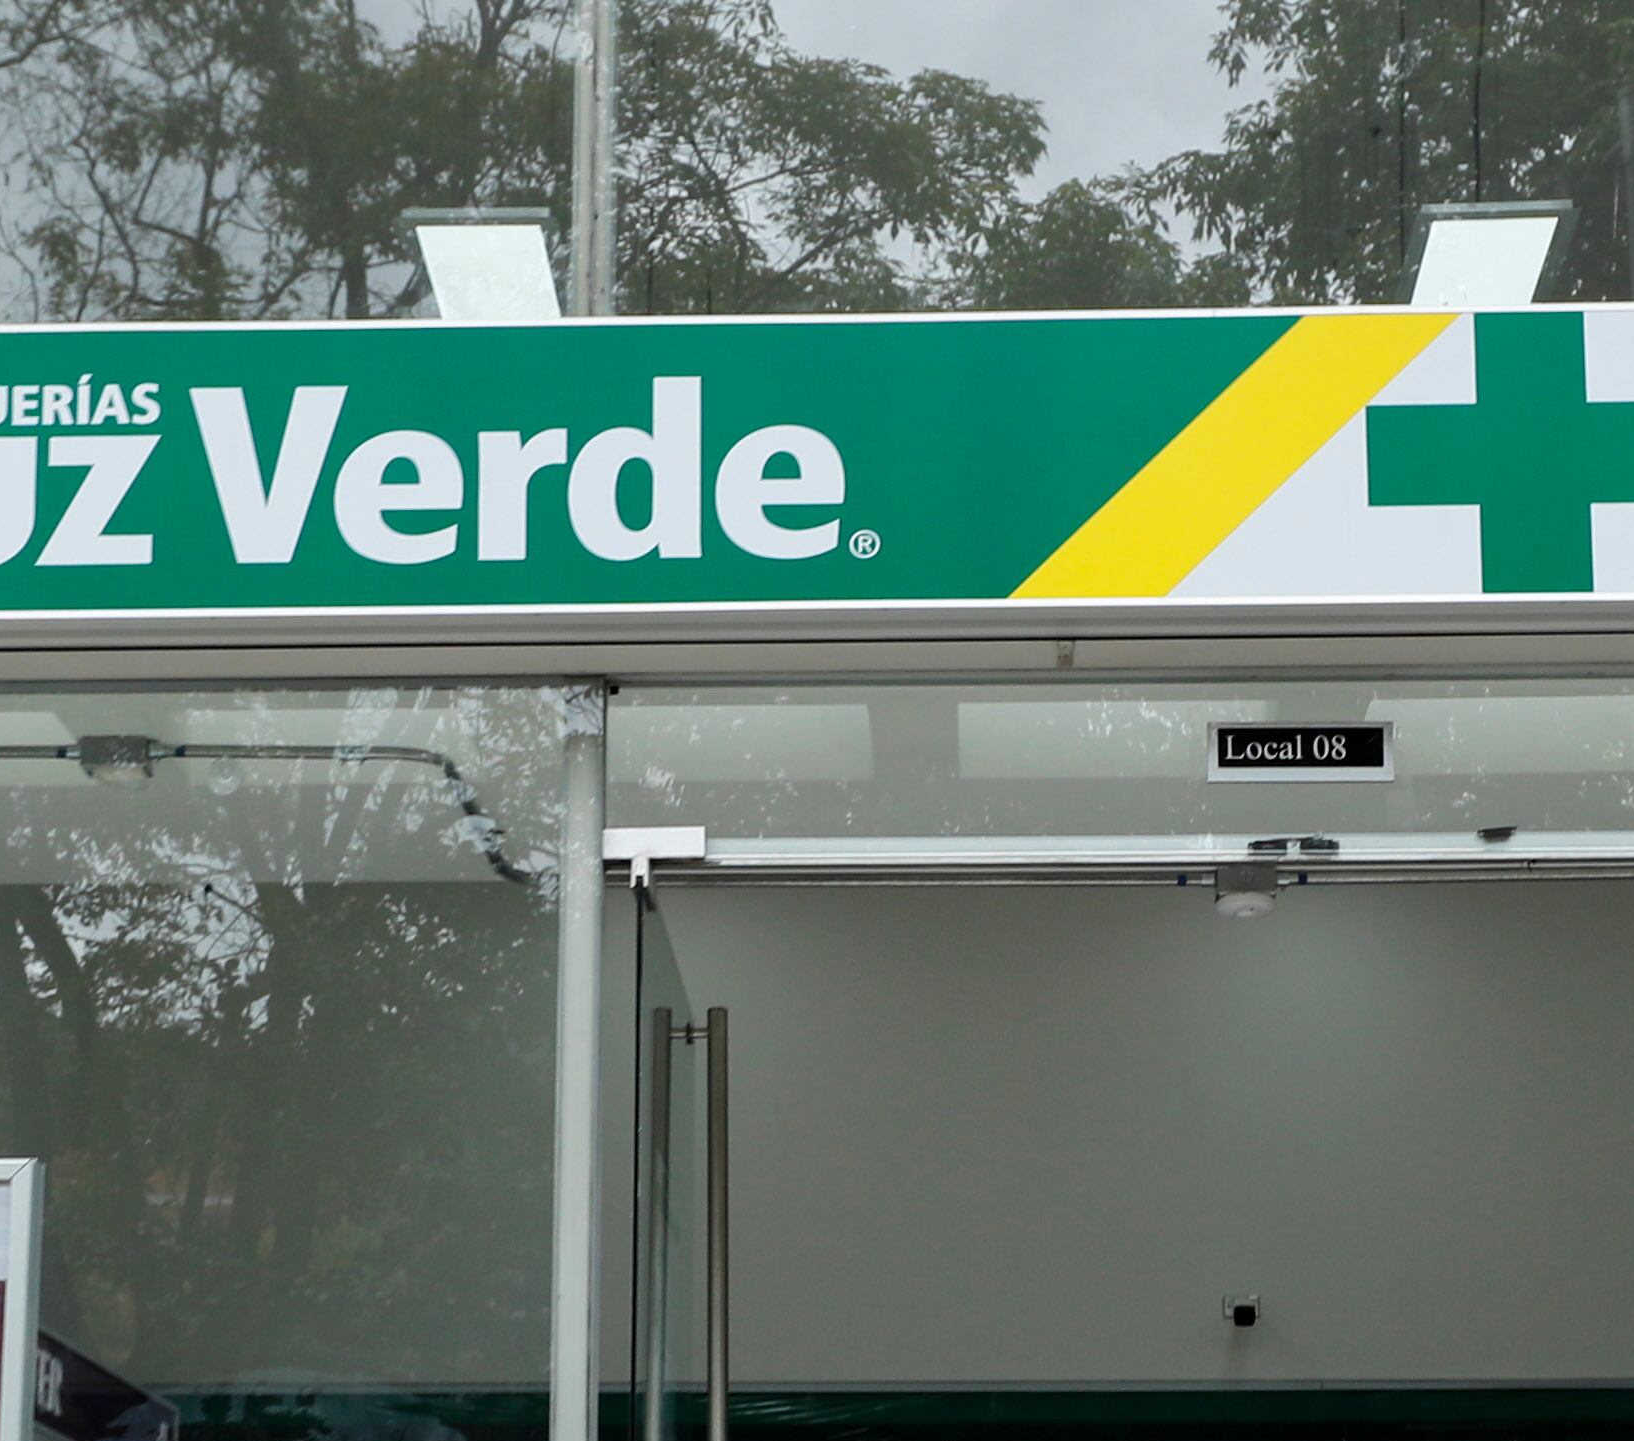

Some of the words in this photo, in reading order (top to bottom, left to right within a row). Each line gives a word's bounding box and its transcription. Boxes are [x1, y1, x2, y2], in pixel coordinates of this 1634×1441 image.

[189, 376, 847, 566] Verde
[1224, 734, 1303, 761] Local
[1312, 733, 1347, 761] 08
